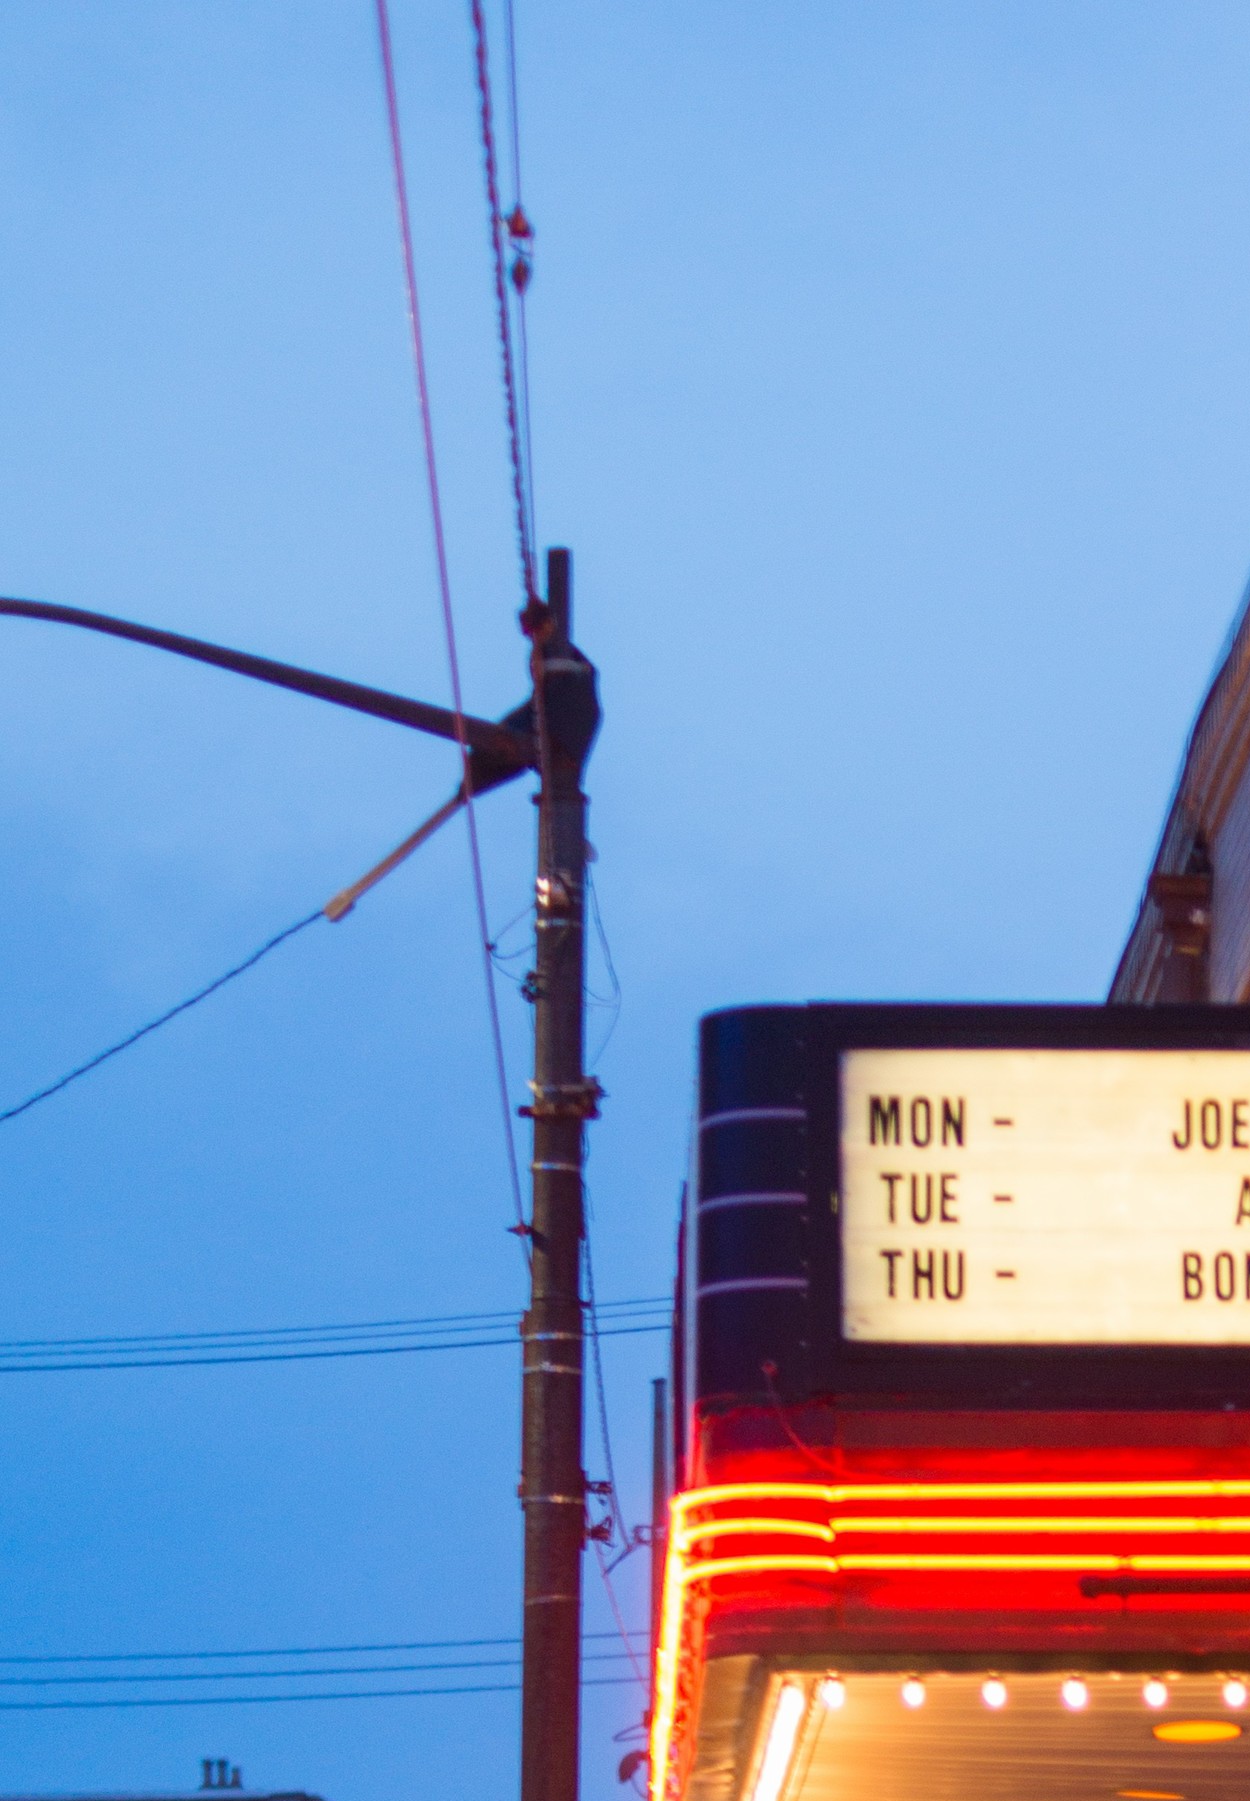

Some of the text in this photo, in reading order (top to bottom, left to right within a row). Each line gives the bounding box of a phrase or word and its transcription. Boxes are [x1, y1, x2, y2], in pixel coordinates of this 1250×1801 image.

[868, 1095, 964, 1148] MON
[1172, 1100, 1249, 1150] JOE
[880, 1172, 959, 1225] TUE
[879, 1249, 965, 1301] THU
